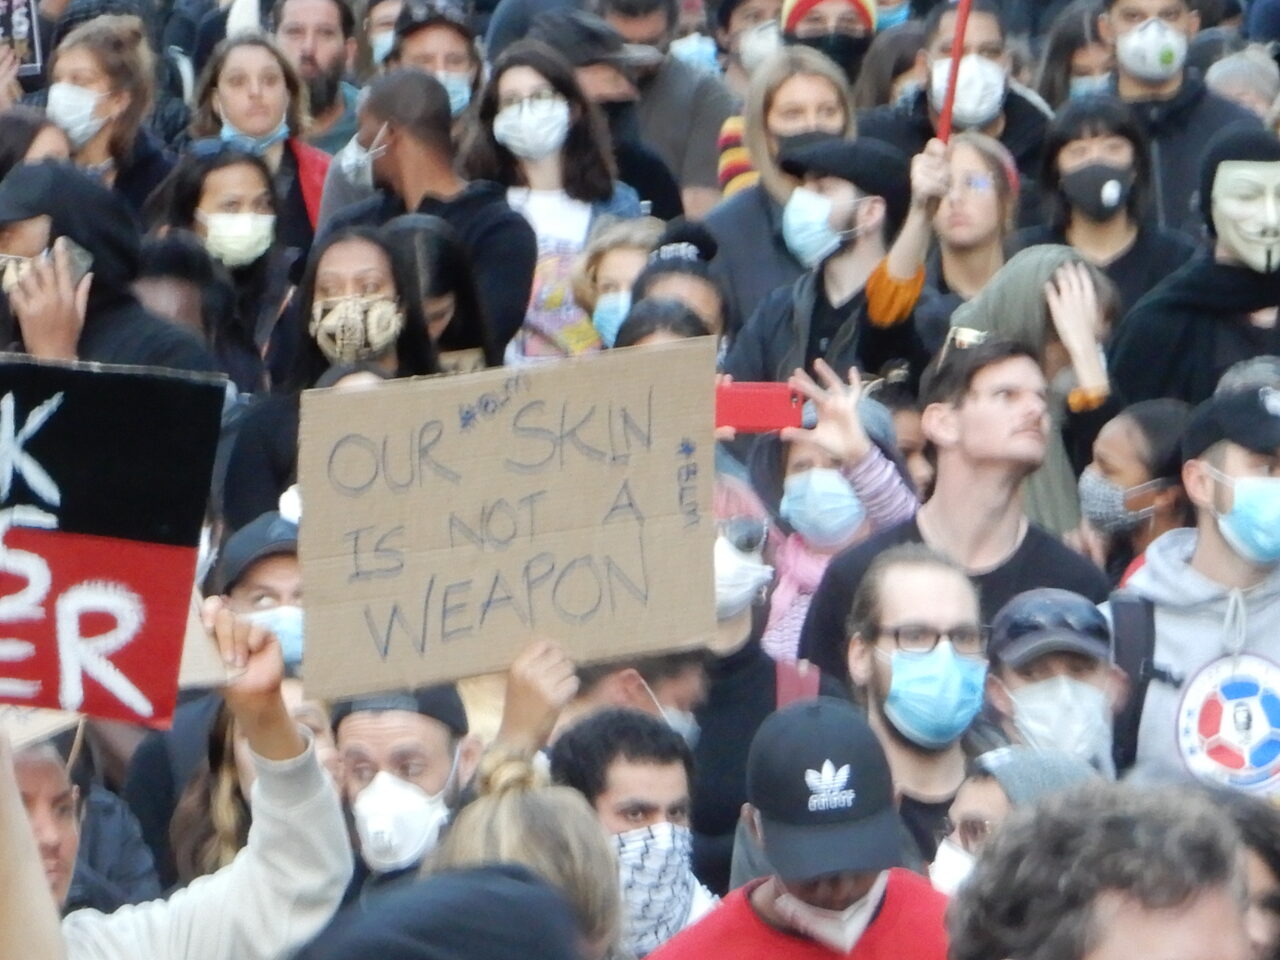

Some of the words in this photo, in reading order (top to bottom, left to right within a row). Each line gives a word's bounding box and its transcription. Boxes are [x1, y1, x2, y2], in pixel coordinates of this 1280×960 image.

[327, 419, 461, 497] OUR
[504, 384, 654, 473] SKIN
[344, 525, 406, 582] IS
[448, 490, 548, 551] NOT
[603, 478, 646, 527] A
[363, 524, 649, 661] WEAPON
